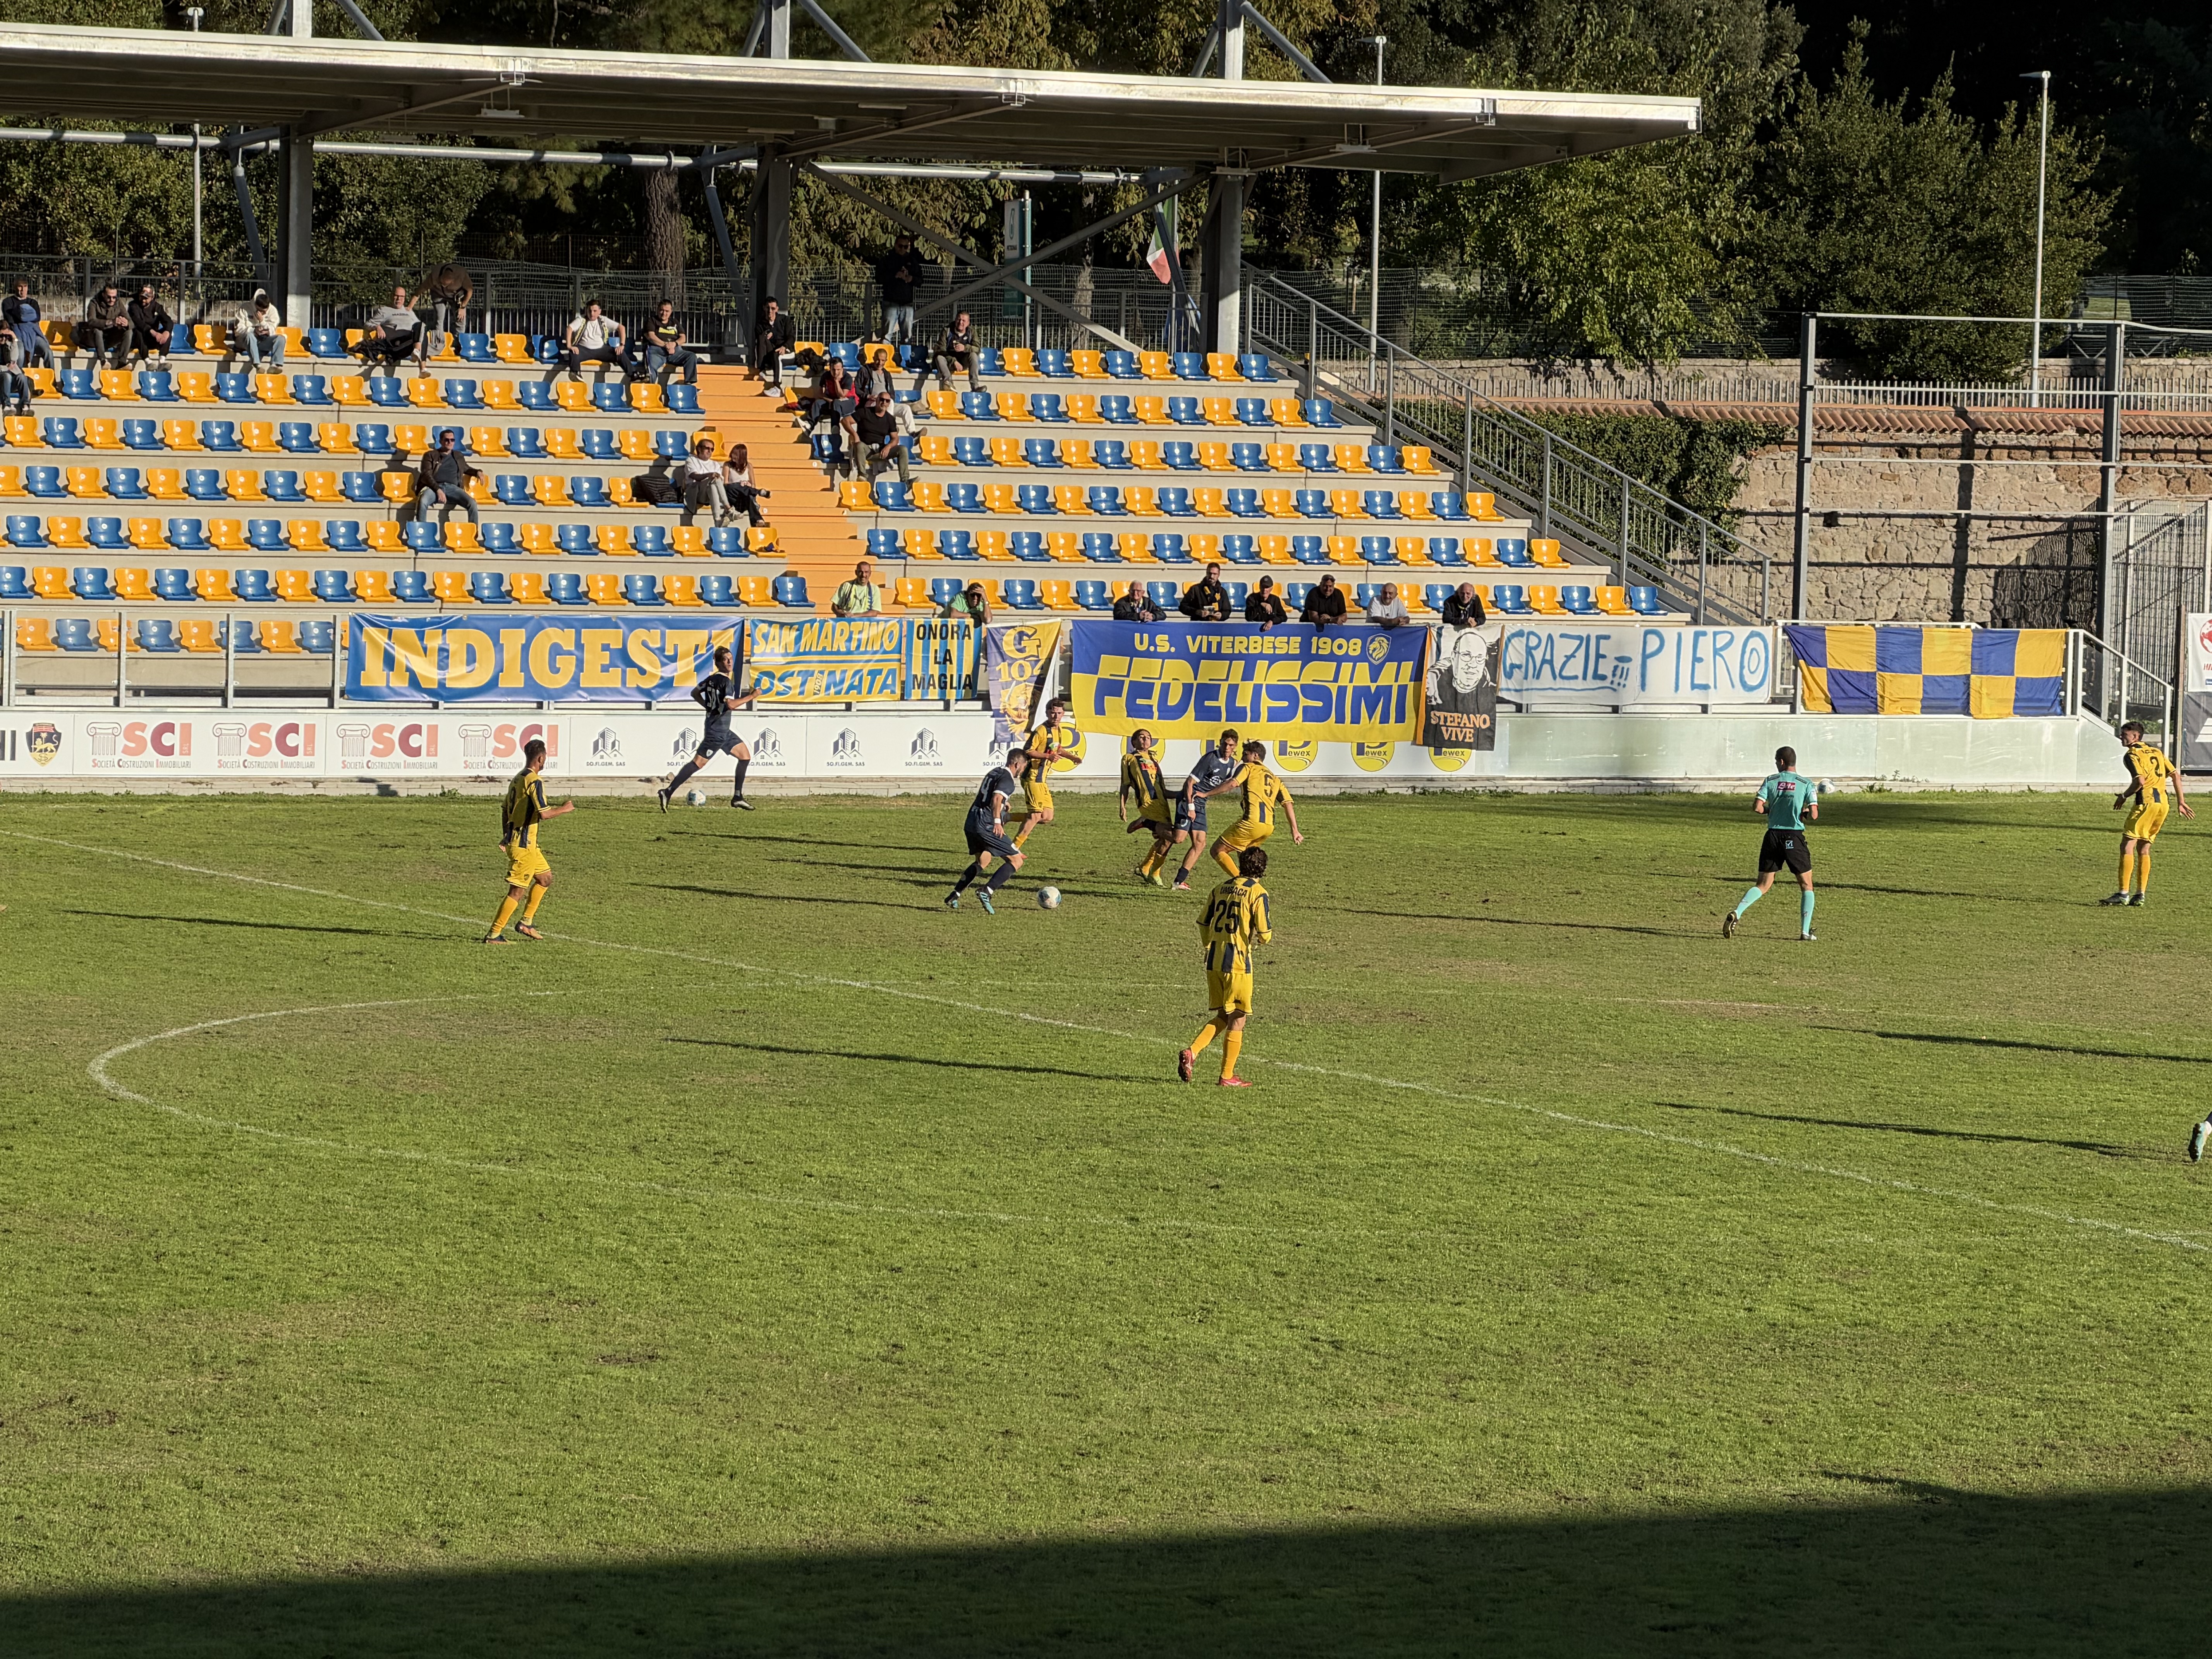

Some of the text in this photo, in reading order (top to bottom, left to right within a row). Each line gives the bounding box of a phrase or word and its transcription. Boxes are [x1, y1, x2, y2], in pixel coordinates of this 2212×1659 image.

[754, 620, 900, 653] SAN MARTINO
[916, 624, 972, 640] ONORA
[1135, 633, 1361, 656] U.S. VITERBESE 1908
[934, 649, 953, 665] LA
[1640, 629, 1769, 692] PIERO
[912, 673, 973, 690] MAGLIA
[1094, 654, 1414, 725] FEDELISSIMI
[1431, 710, 1490, 729] STEFANO
[121, 722, 192, 756] SCI
[246, 723, 316, 757] SCI
[369, 723, 438, 758] SCI
[1441, 726, 1474, 742] VIVE
[1434, 747, 1465, 756] ewex
[92, 758, 191, 768] SOCIETÀ COSTRUZIONI IMMOBILIARI
[217, 759, 315, 769] SOCIETÀ COSTRUZIONI IMMOBILIARI
[341, 760, 437, 769] SOCIETÀ COSTRUZIONI IMMOBILIARI
[463, 760, 486, 769] SOCIETÀ
[2150, 756, 2163, 777] 2
[1264, 773, 1273, 797] 5
[1214, 900, 1241, 934] 25
